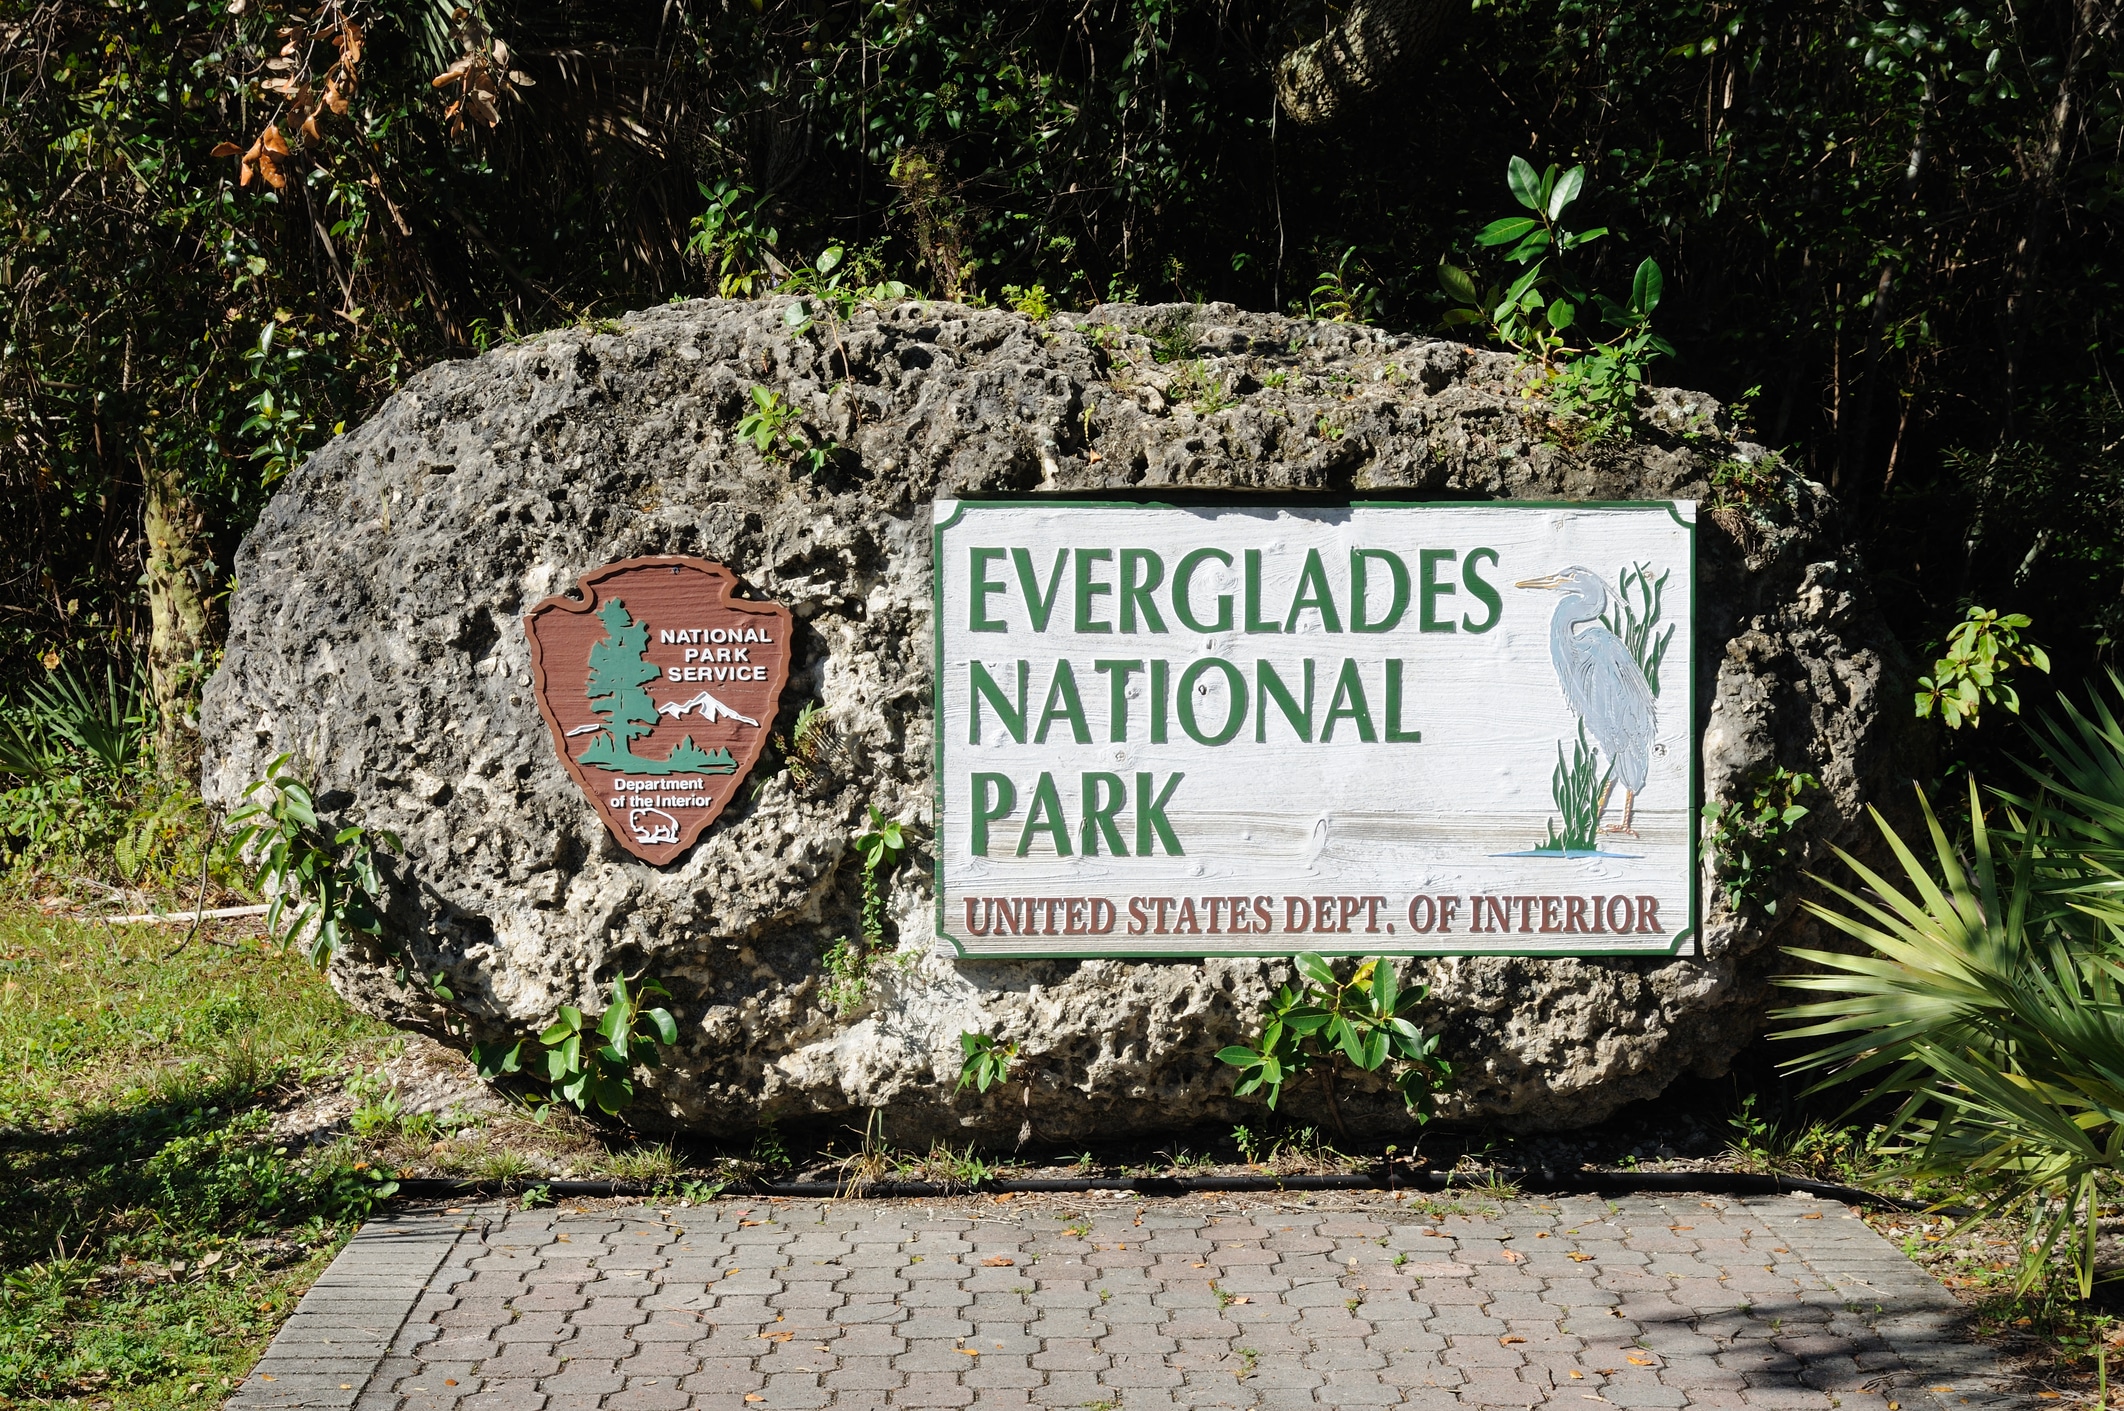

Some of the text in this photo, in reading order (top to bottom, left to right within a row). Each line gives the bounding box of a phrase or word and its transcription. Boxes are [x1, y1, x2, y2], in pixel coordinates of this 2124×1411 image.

[969, 546, 1502, 634] EVERGLADES
[660, 628, 773, 644] NATIONAL
[685, 647, 749, 663] PARK
[668, 666, 767, 682] SERVICE
[969, 657, 1422, 746] NATIONAL
[614, 778, 704, 794] Department
[610, 795, 712, 808] of the Interior
[970, 771, 1186, 857] PARK
[963, 894, 1662, 936] UNITED STATES DEPT. OF INTERIOR
